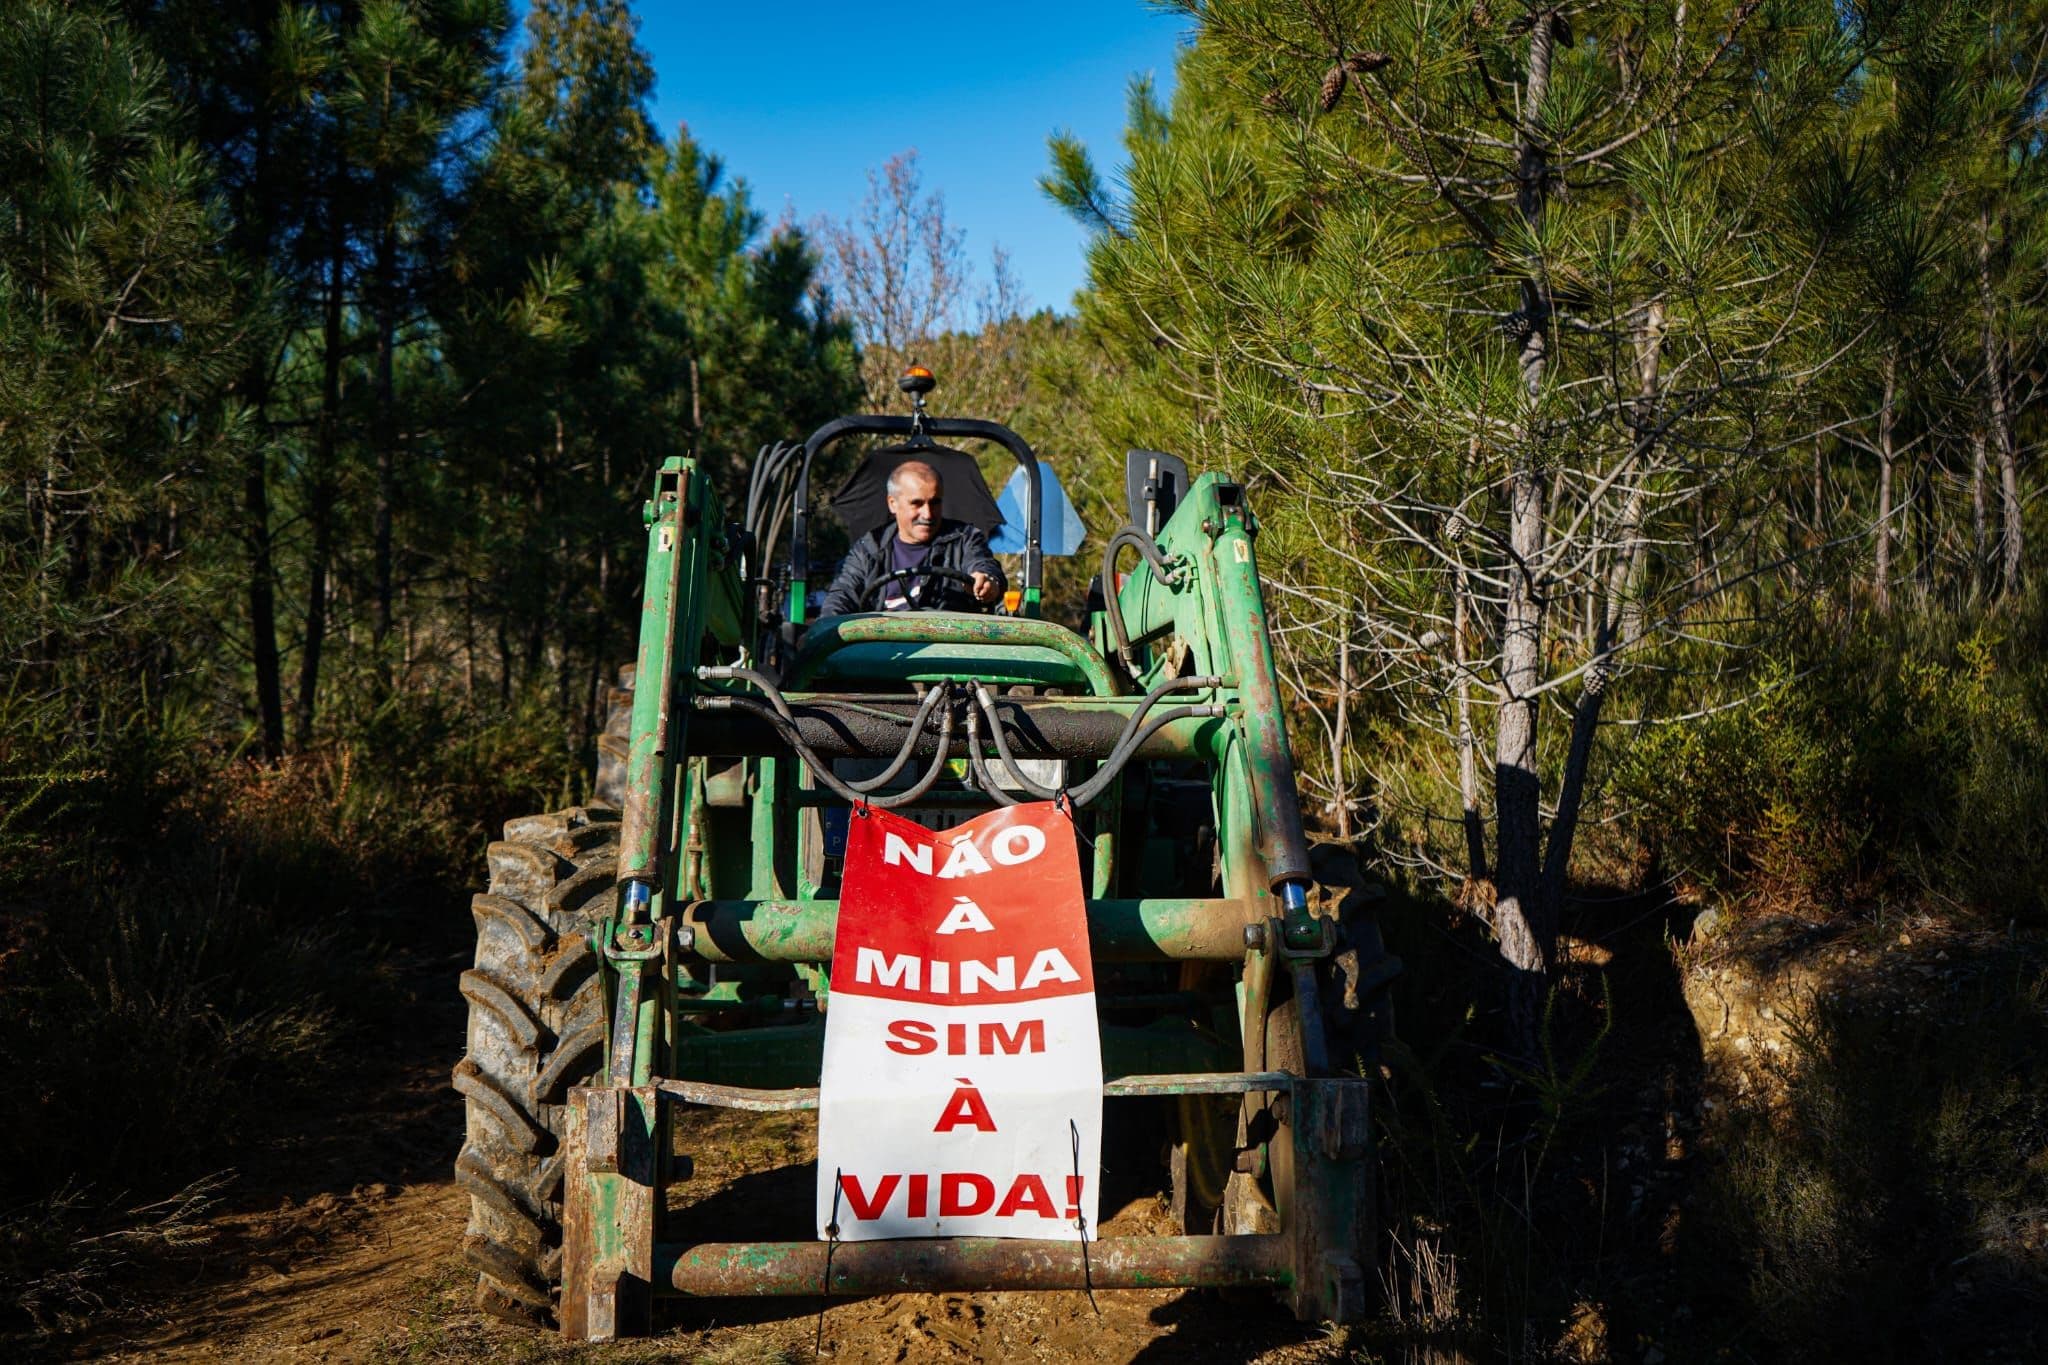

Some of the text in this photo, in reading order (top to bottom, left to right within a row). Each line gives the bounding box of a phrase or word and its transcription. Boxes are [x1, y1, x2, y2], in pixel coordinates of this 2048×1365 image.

[884, 824, 1046, 879] NÃO
[935, 895, 996, 935] À
[855, 946, 1081, 994] MINA
[885, 1019, 1046, 1056] SIM
[933, 1077, 998, 1132] À
[840, 1172, 1085, 1221] VIDA!
